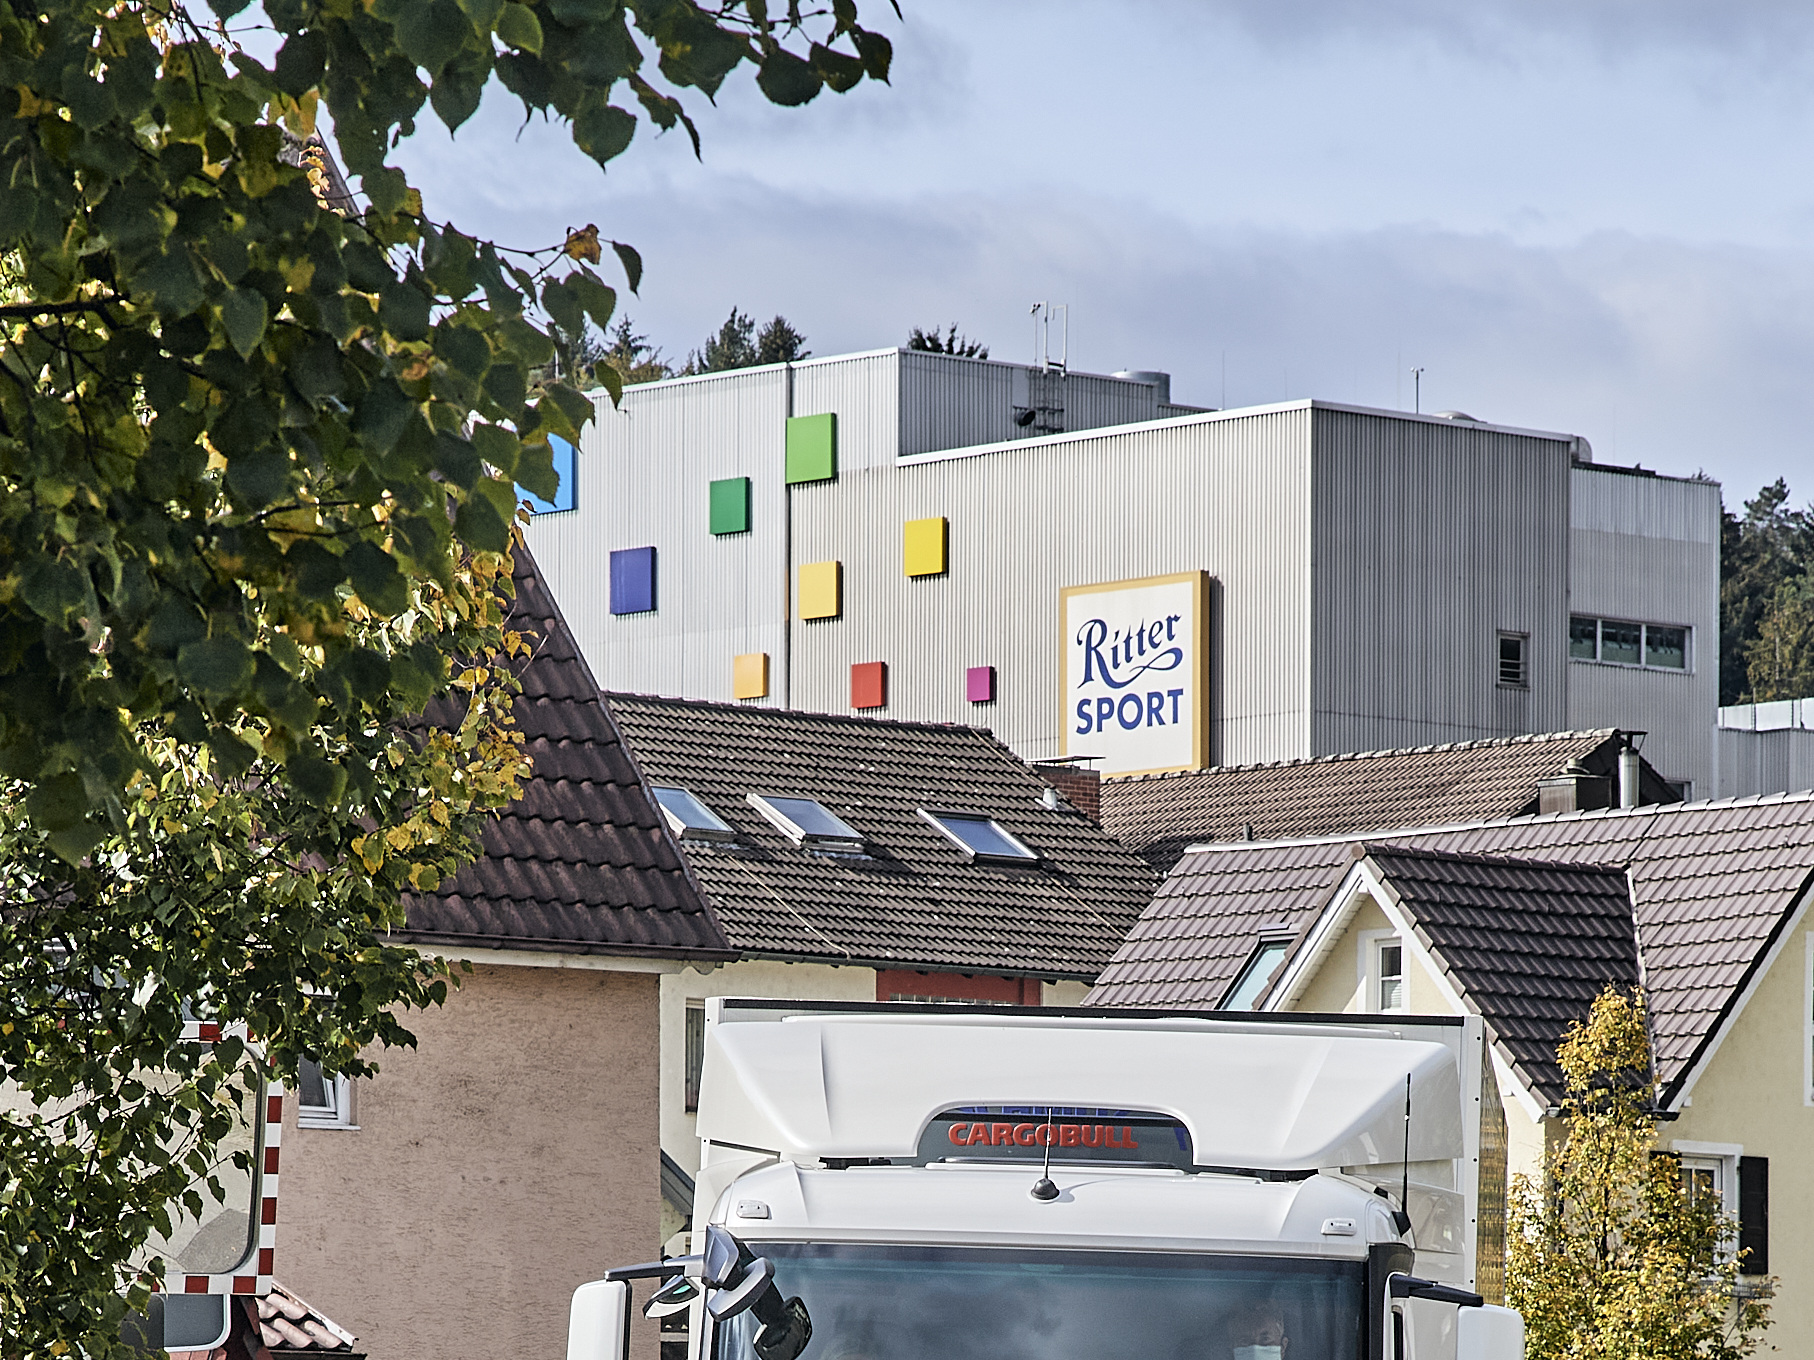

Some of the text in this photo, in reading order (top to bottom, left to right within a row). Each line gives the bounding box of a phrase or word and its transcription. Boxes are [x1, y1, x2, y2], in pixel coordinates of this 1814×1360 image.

[1077, 612, 1184, 689] Ritter
[1076, 688, 1184, 735] SPORT
[948, 1122, 1139, 1149] CARGOBULL
